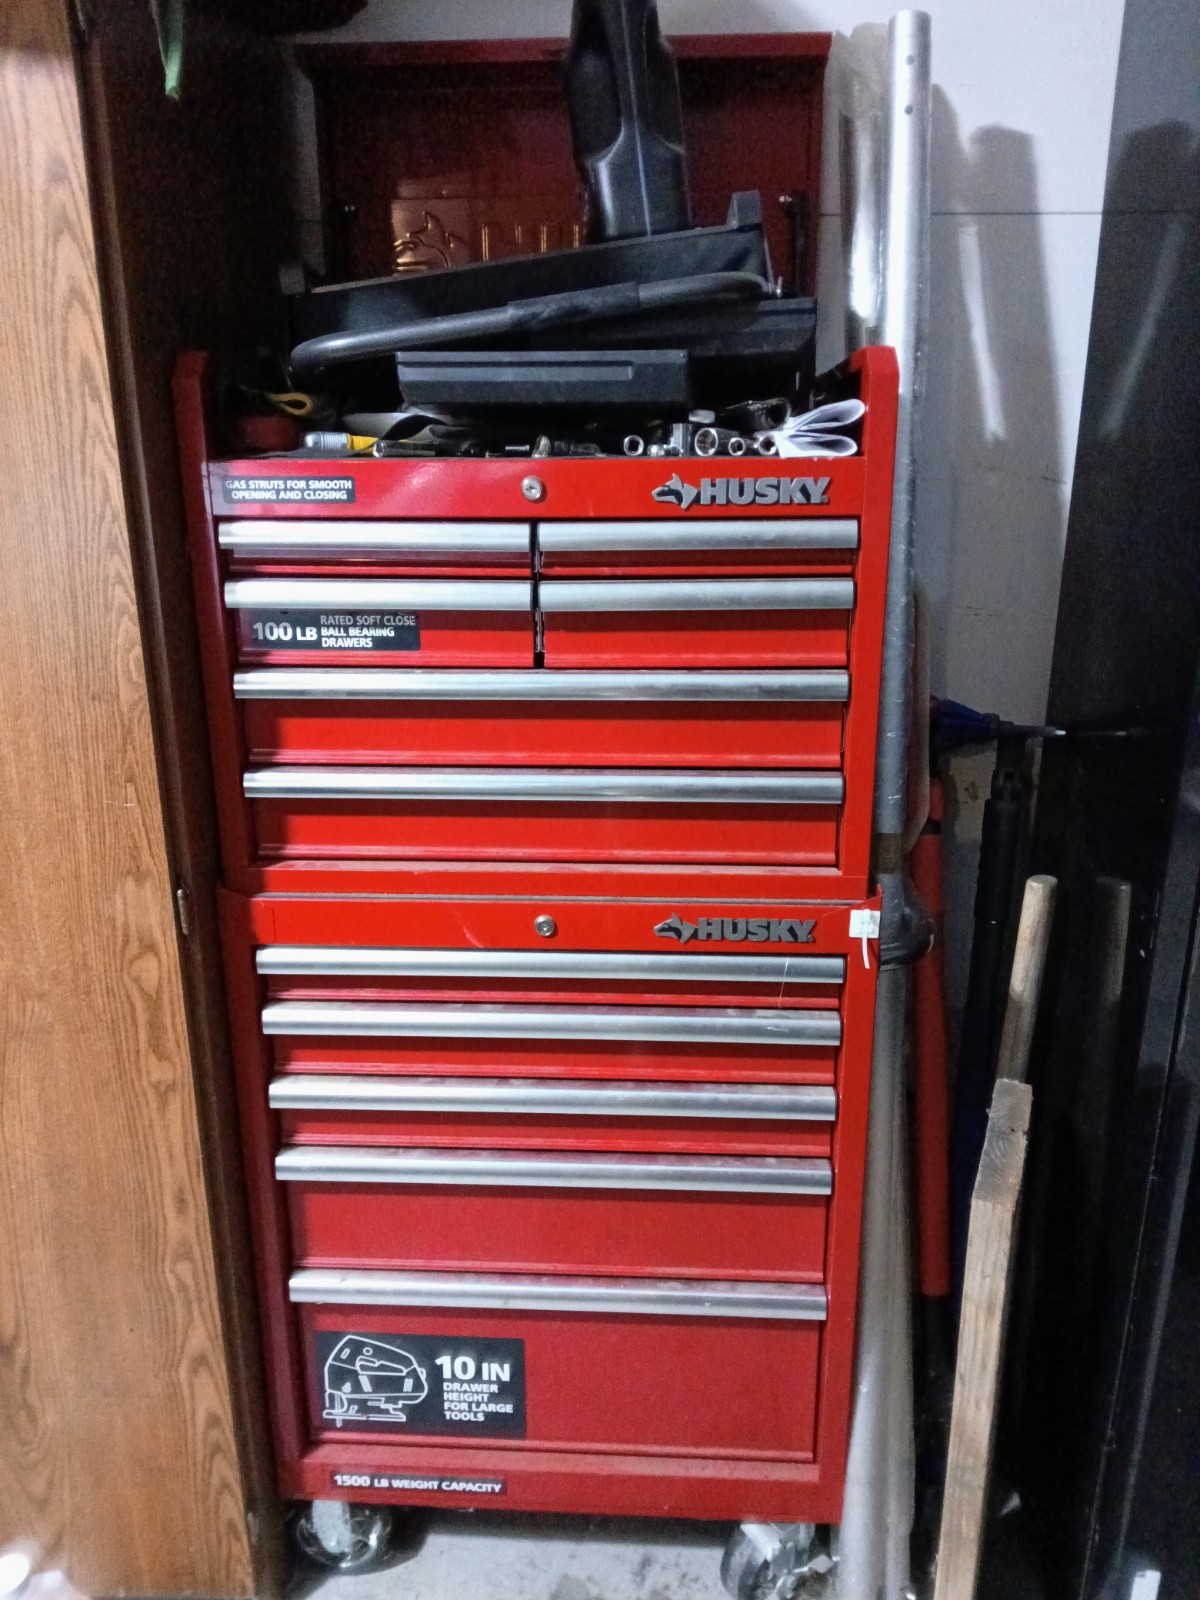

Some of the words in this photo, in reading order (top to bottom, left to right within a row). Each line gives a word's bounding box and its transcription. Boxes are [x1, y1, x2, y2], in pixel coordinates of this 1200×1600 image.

[225, 480, 246, 490] GAS
[248, 480, 284, 490] STRUTS
[286, 480, 306, 490] FOR
[309, 480, 352, 490] SMOOTH
[232, 490, 276, 500] OPENING
[279, 490, 302, 500] AND
[304, 490, 348, 500] CLOSING
[320, 615, 354, 626] RATED
[356, 615, 381, 626] SOFT
[384, 615, 416, 626] CLOSE
[252, 622, 292, 641] 100
[296, 626, 318, 641] LB
[321, 626, 347, 637] BALL
[348, 626, 395, 637] BEARING
[322, 637, 373, 648] DRAWERS
[434, 1356, 476, 1380] 10
[482, 1362, 510, 1382] IN
[442, 1382, 499, 1393] DRAWER
[444, 1392, 490, 1402] HEIGHT
[444, 1401, 469, 1411] FOR
[472, 1402, 514, 1414] LARGE
[444, 1410, 484, 1421] TOOLS
[334, 1474, 370, 1487] 1500
[374, 1478, 389, 1488] LB
[391, 1478, 439, 1490] WEIGHT
[441, 1480, 502, 1493] CAPACITY
